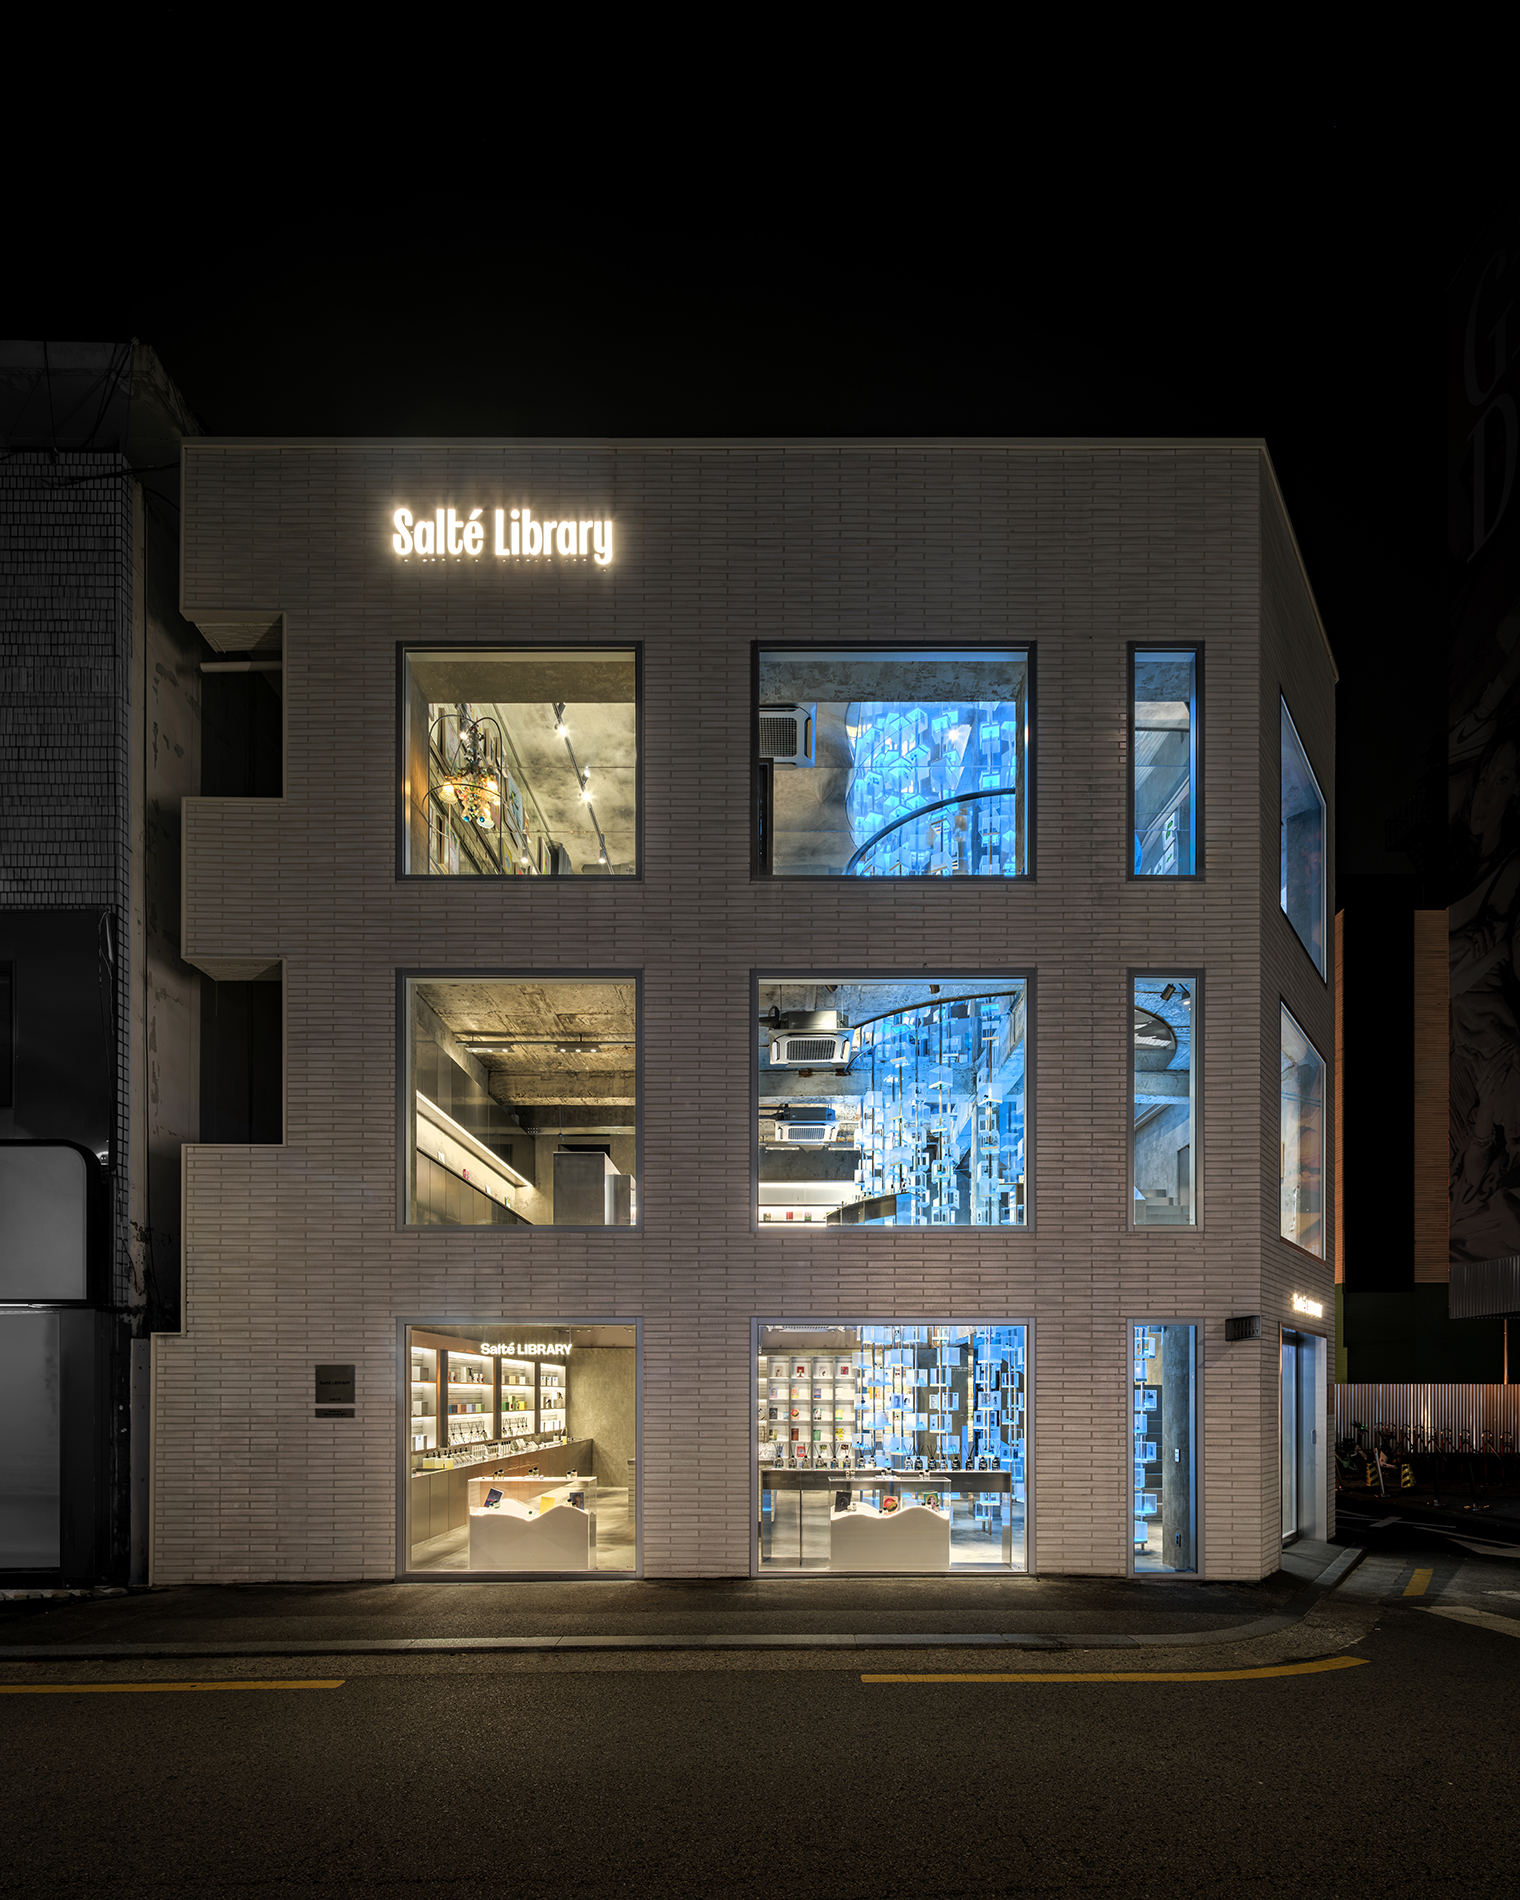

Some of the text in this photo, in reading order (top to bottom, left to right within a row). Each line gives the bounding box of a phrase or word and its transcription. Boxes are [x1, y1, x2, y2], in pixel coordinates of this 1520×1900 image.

[393, 508, 613, 566] Salté Library
[480, 1342, 572, 1355] Salté LIBRARY
